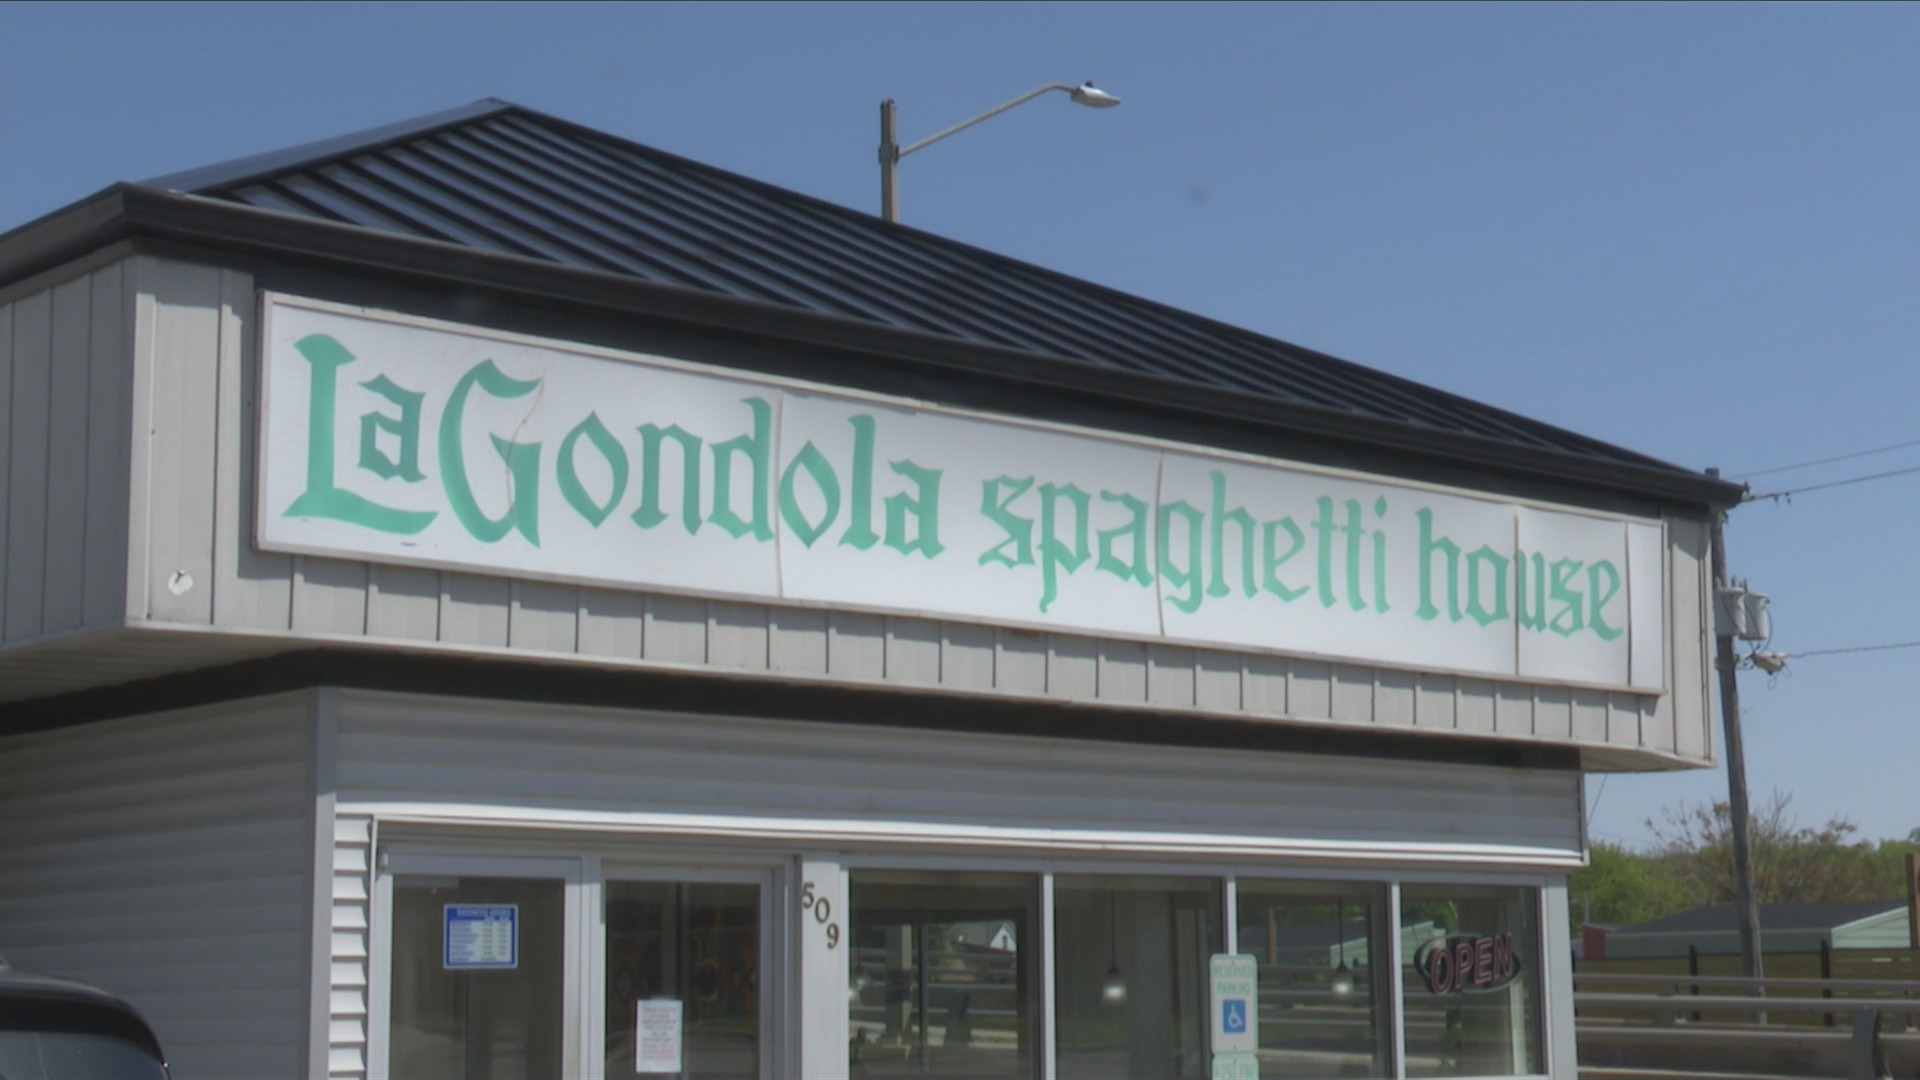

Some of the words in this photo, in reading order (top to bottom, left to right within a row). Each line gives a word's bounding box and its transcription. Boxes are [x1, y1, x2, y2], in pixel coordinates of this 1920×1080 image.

[978, 470, 1391, 613] spaghetti
[1415, 505, 1623, 641] house
[794, 881, 840, 950] 509
[1426, 931, 1514, 997] OPEN
